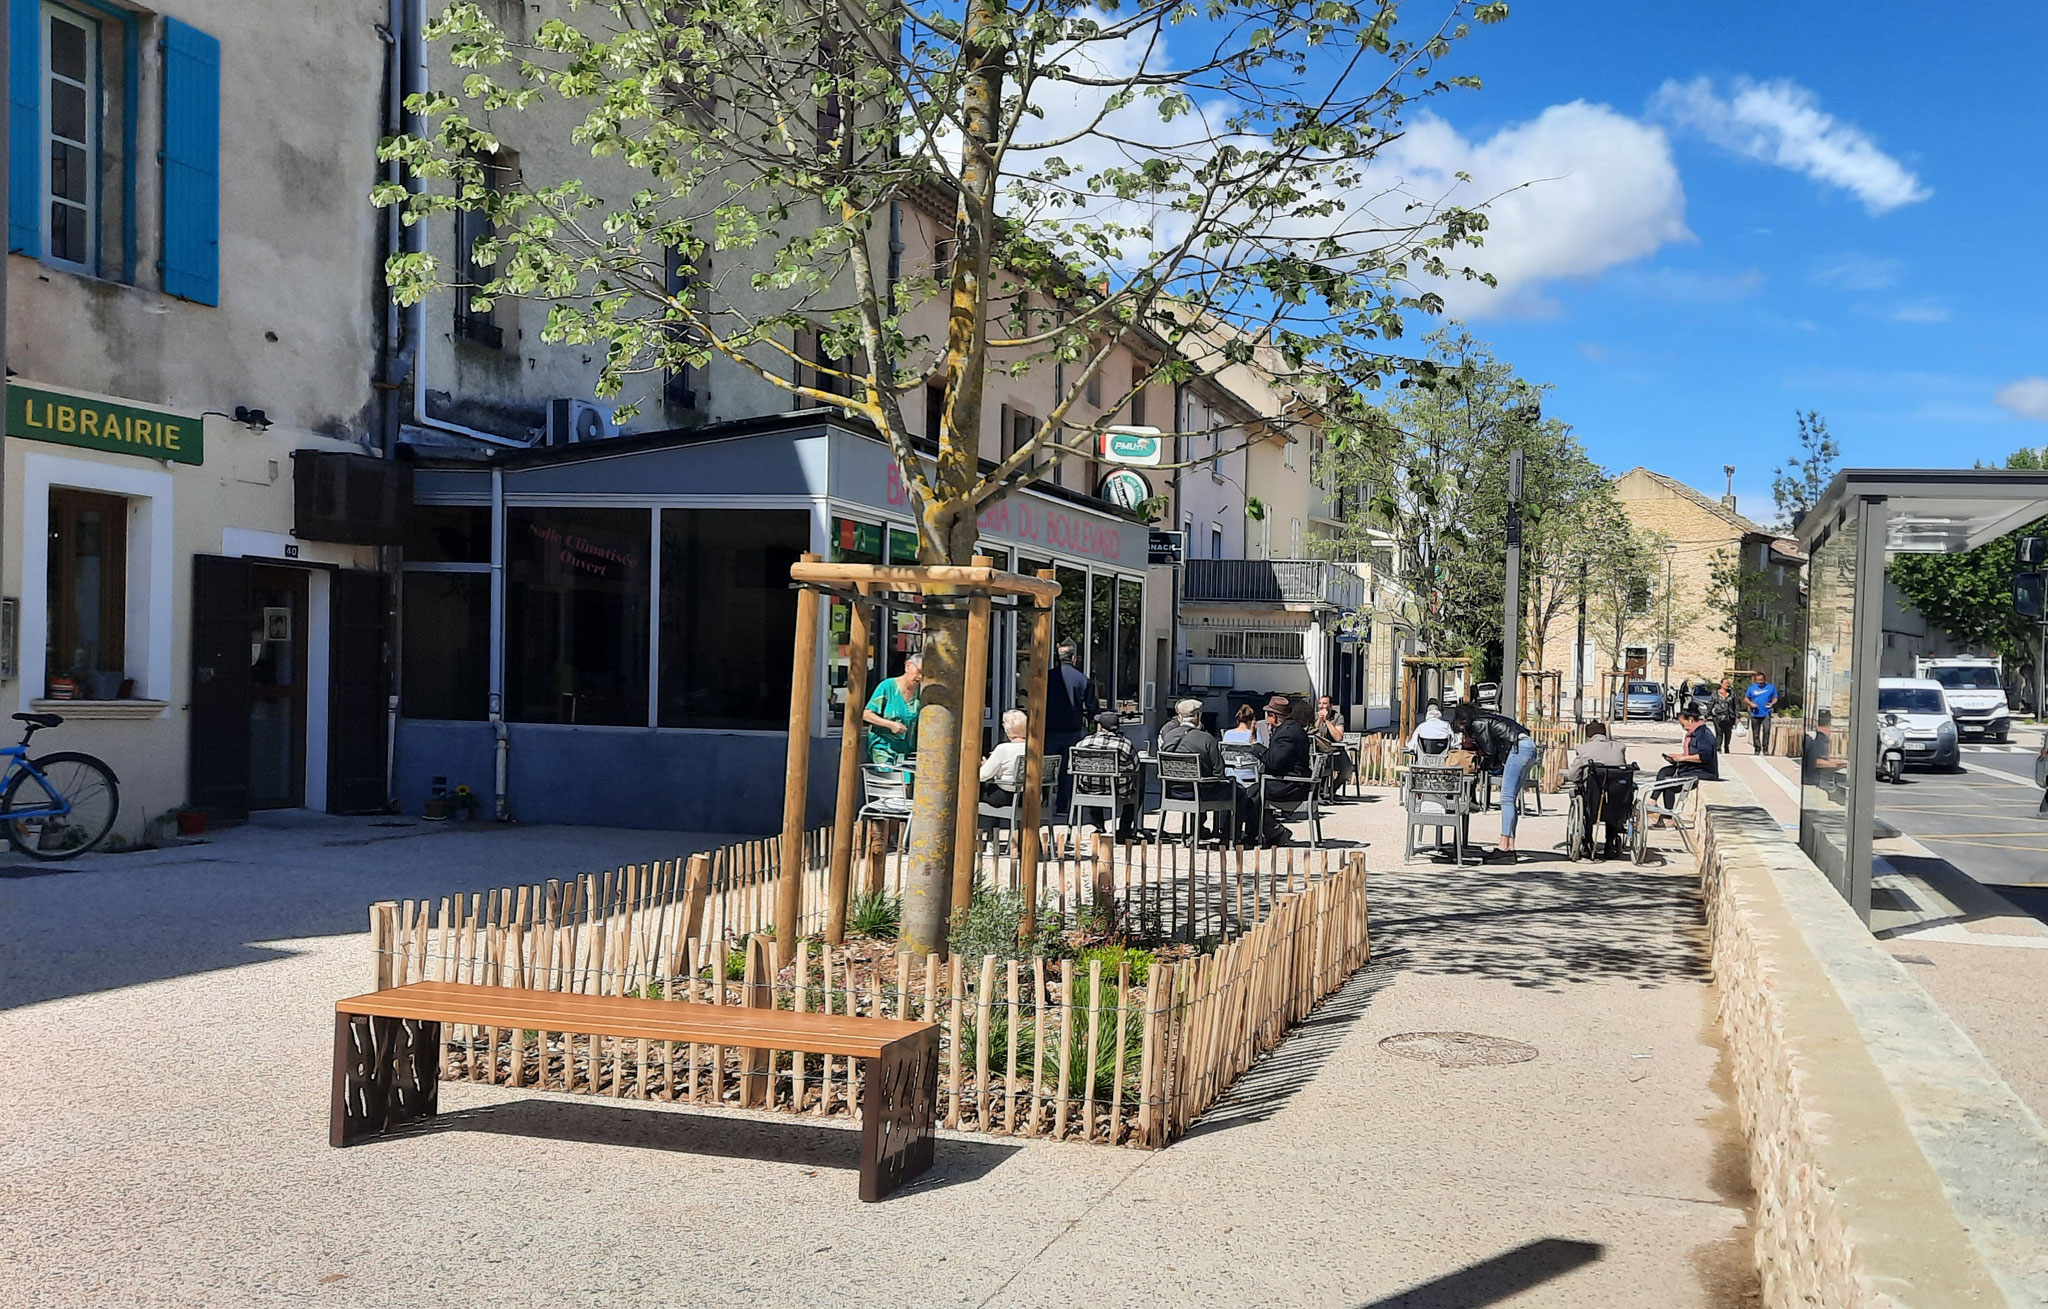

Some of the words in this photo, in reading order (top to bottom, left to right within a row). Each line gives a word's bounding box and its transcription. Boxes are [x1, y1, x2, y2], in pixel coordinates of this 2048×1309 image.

[25, 398, 181, 451] LIBRAIRIE
[1114, 441, 1137, 451] PMU
[1018, 502, 1040, 541] DU
[1047, 511, 1121, 560] BOULEVARD
[285, 546, 298, 556] 40
